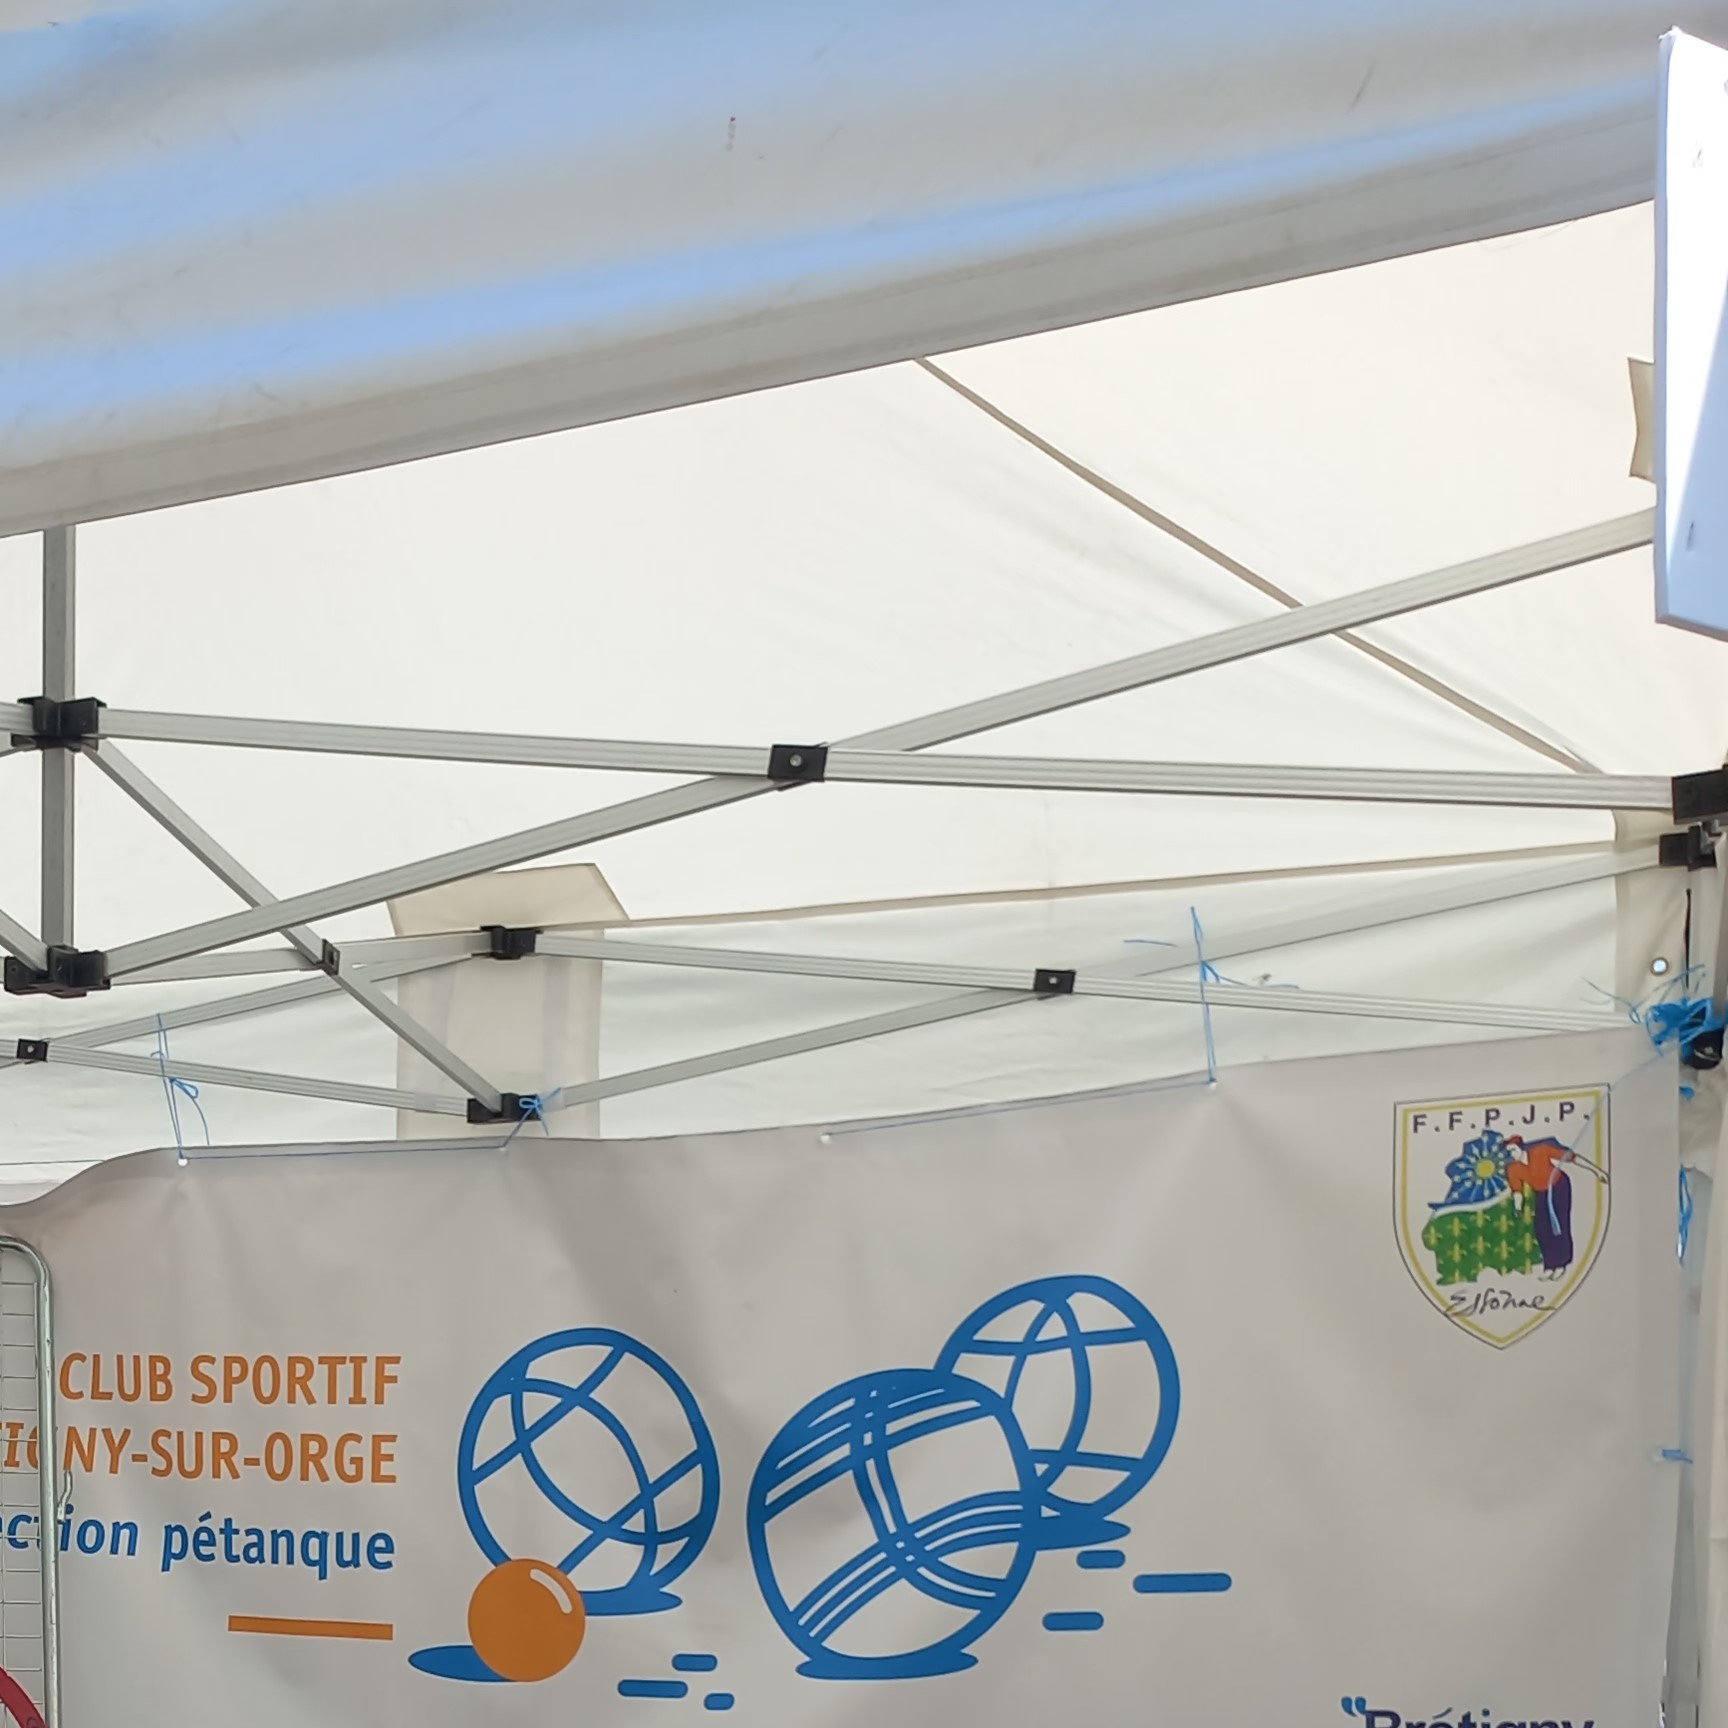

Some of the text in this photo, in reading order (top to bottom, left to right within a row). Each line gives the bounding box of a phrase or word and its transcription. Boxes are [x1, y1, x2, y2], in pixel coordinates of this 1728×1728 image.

[59, 1352, 402, 1405] CLUB SPORTIF
[161, 1511, 396, 1581] pétanque
